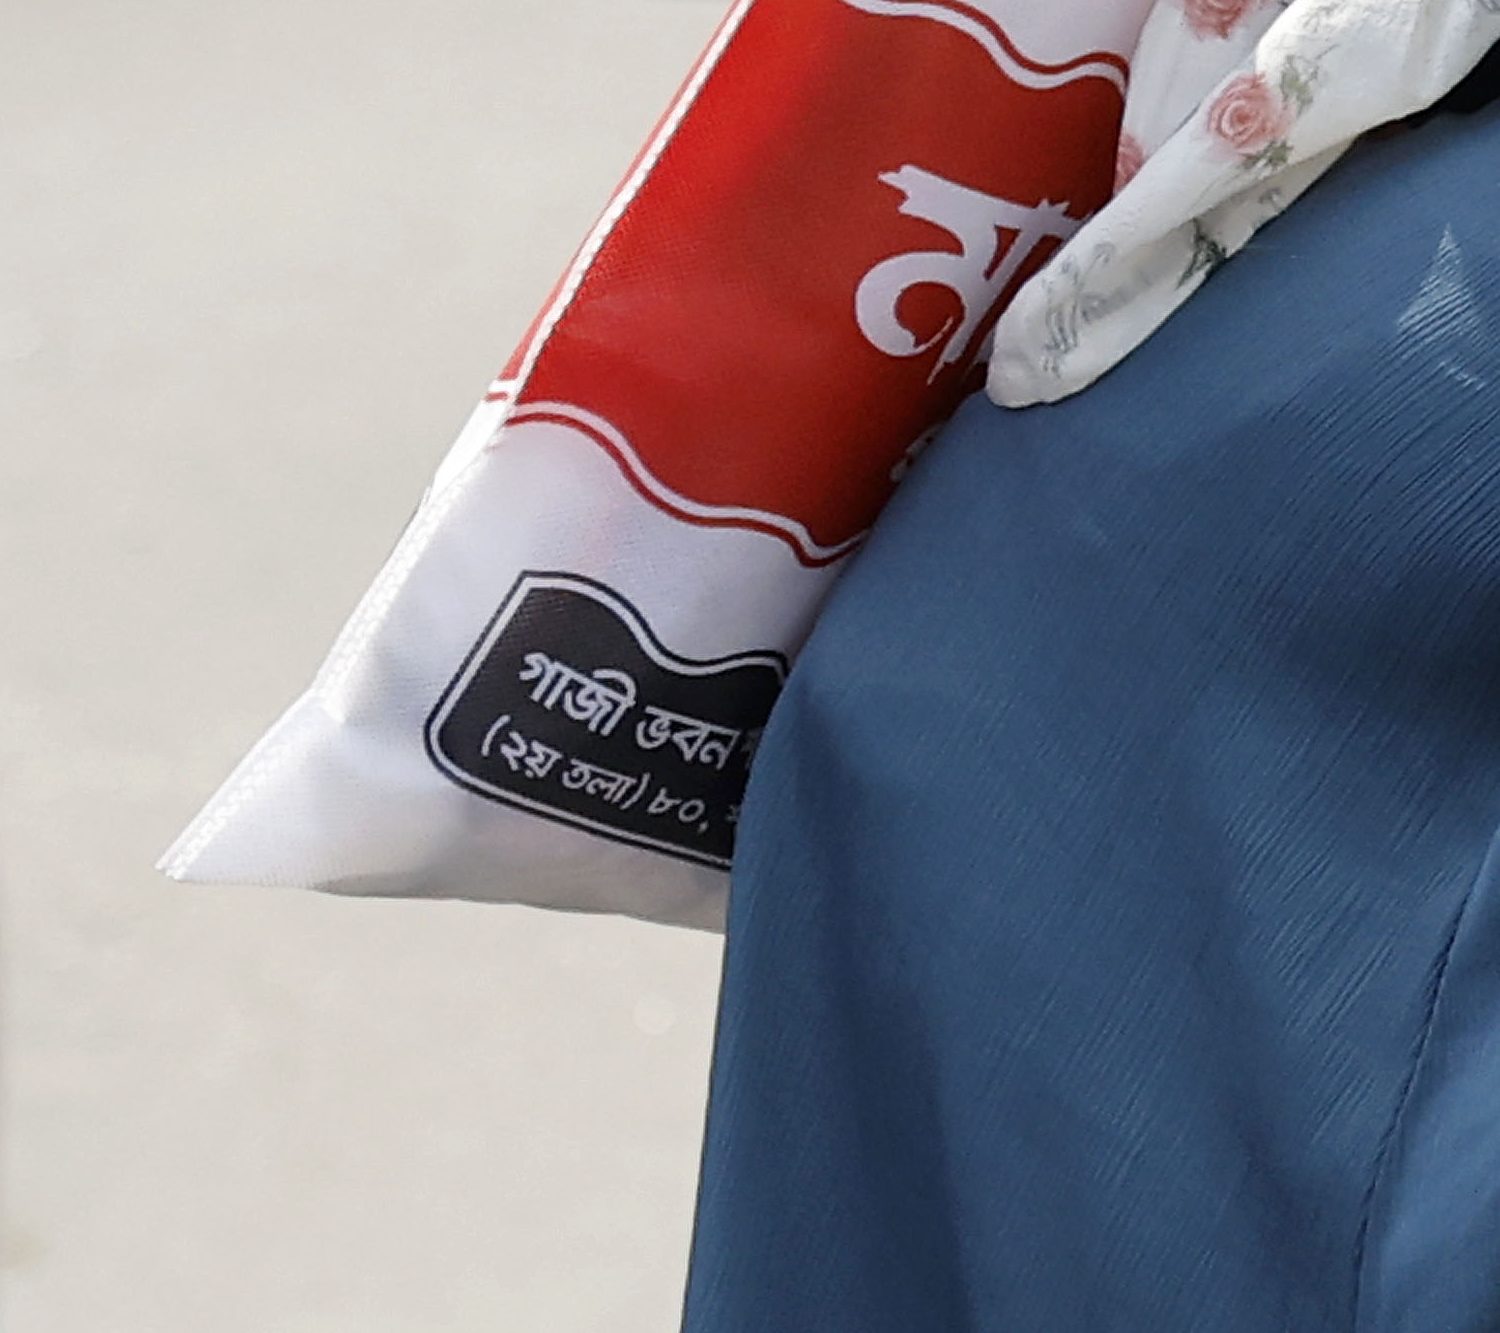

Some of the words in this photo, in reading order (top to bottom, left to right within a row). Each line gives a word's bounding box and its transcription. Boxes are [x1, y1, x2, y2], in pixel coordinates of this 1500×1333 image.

[519, 652, 636, 735] গাজী
[636, 706, 740, 770] ভবন
[562, 760, 650, 811] তলা)
